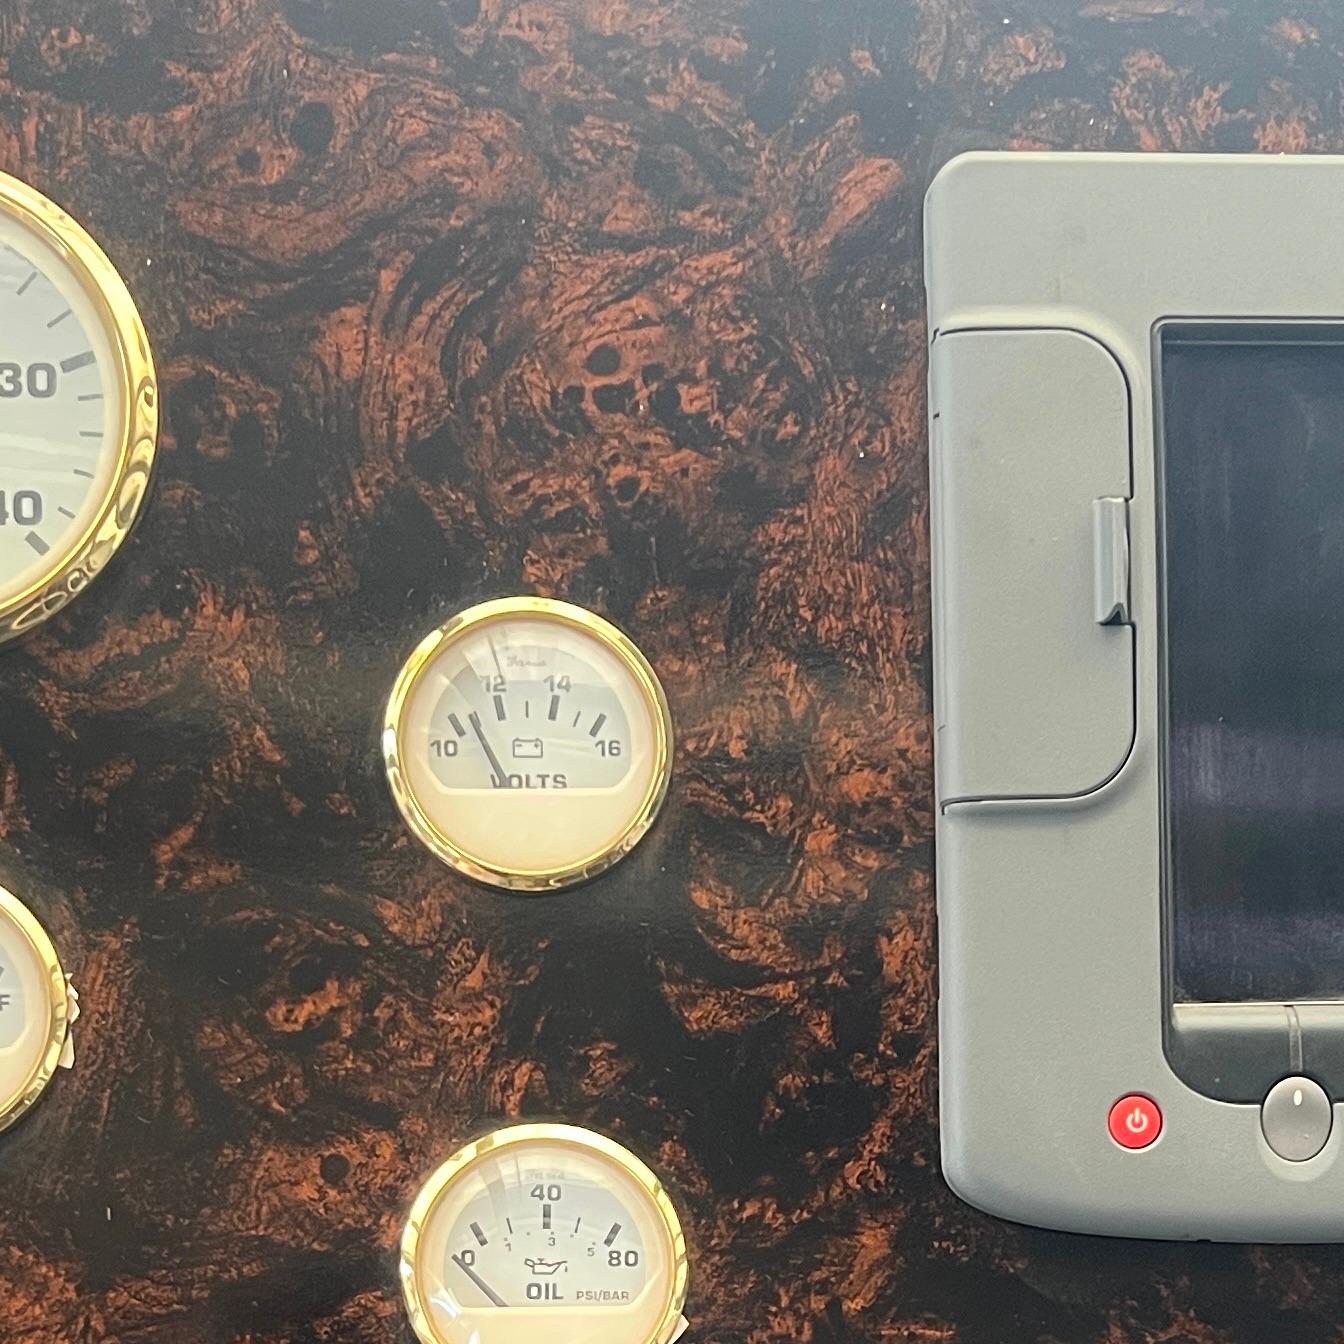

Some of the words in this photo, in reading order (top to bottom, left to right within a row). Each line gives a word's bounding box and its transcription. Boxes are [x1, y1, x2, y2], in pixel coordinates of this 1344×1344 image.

[483, 675, 507, 692] 12
[544, 675, 572, 692] 14
[430, 740, 458, 757] 10
[595, 740, 622, 757] 16
[490, 774, 567, 790] VOLTS
[530, 1184, 562, 1201] 40
[608, 1250, 639, 1268] 80
[526, 1282, 564, 1300] OIL
[576, 1290, 630, 1300] PSI/BAR
